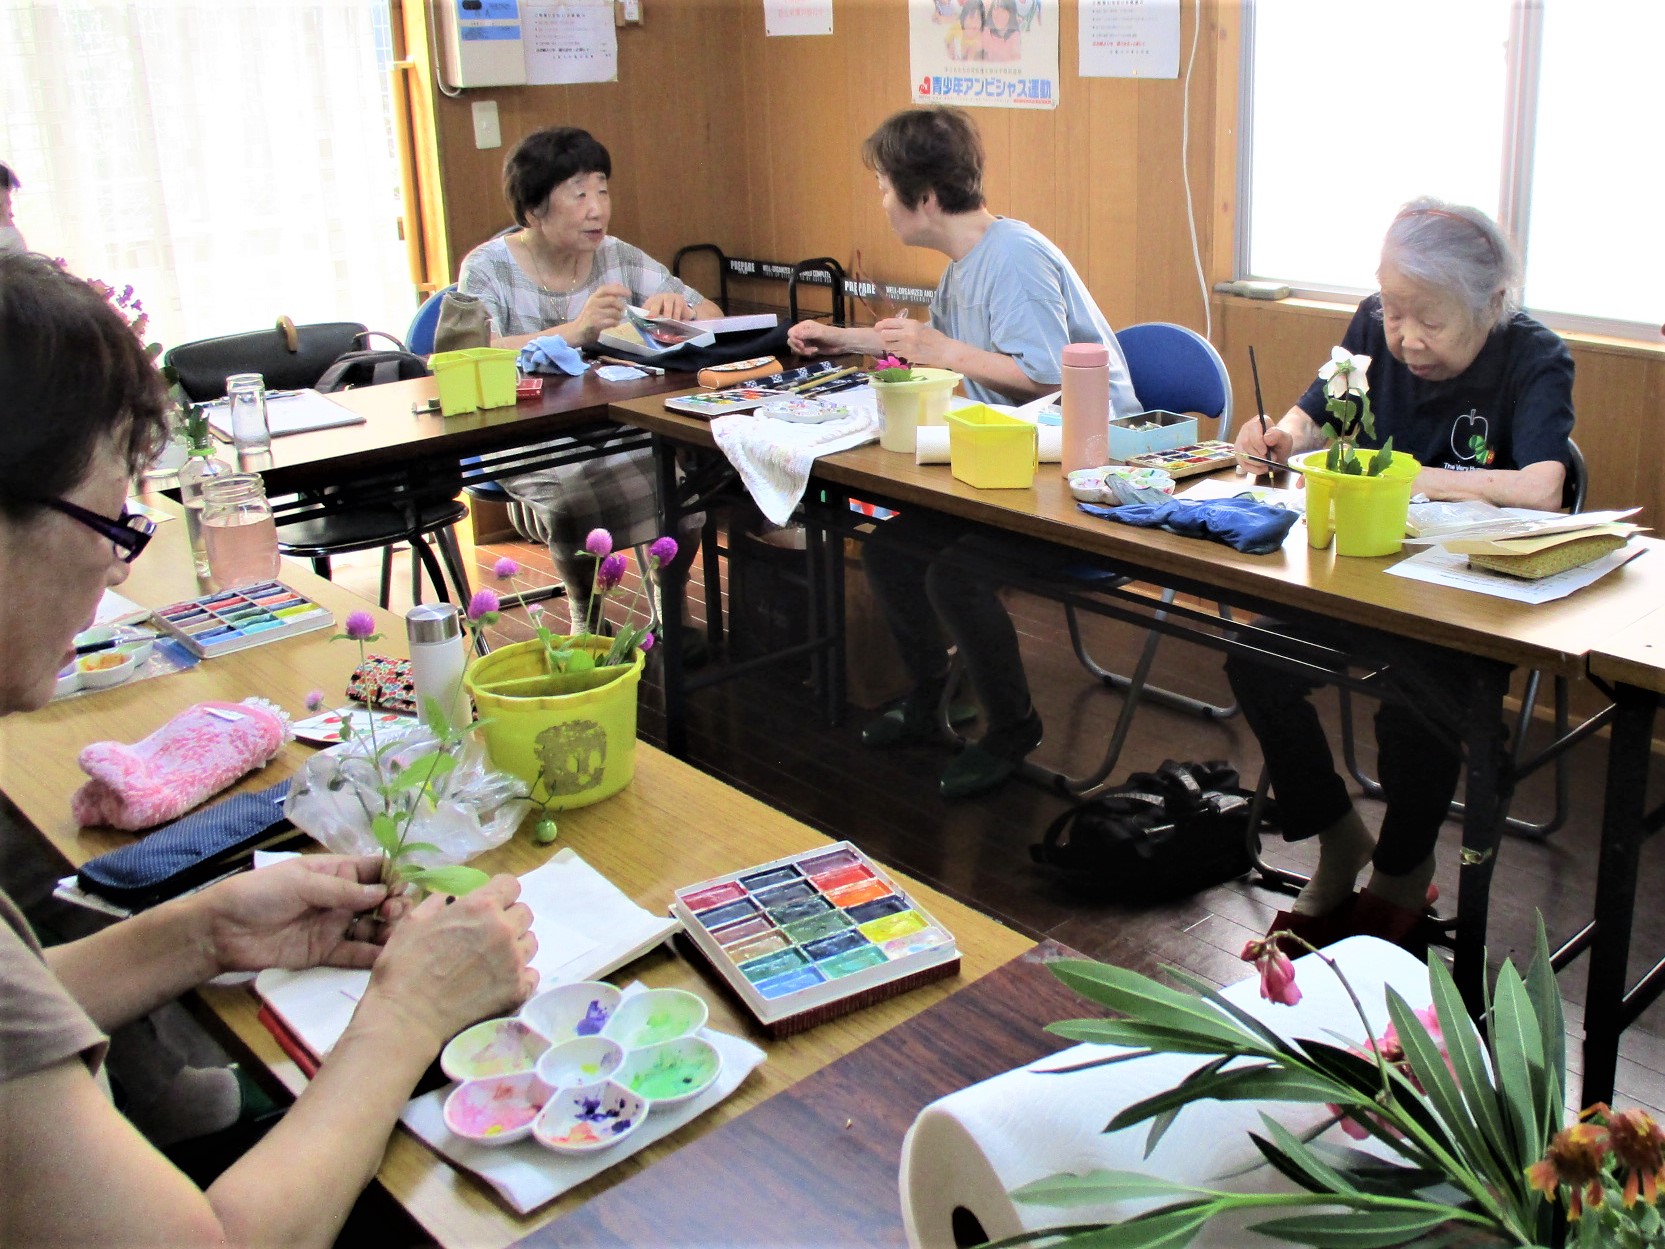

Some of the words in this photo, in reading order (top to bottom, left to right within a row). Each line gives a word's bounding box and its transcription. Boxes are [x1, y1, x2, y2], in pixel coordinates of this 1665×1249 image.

[932, 76, 1052, 99] 青少年アンビシャス運動
[730, 260, 755, 273] PREPARE
[844, 280, 876, 295] PREPARE
[1443, 462, 1455, 470] The
[1456, 464, 1469, 472] Very
